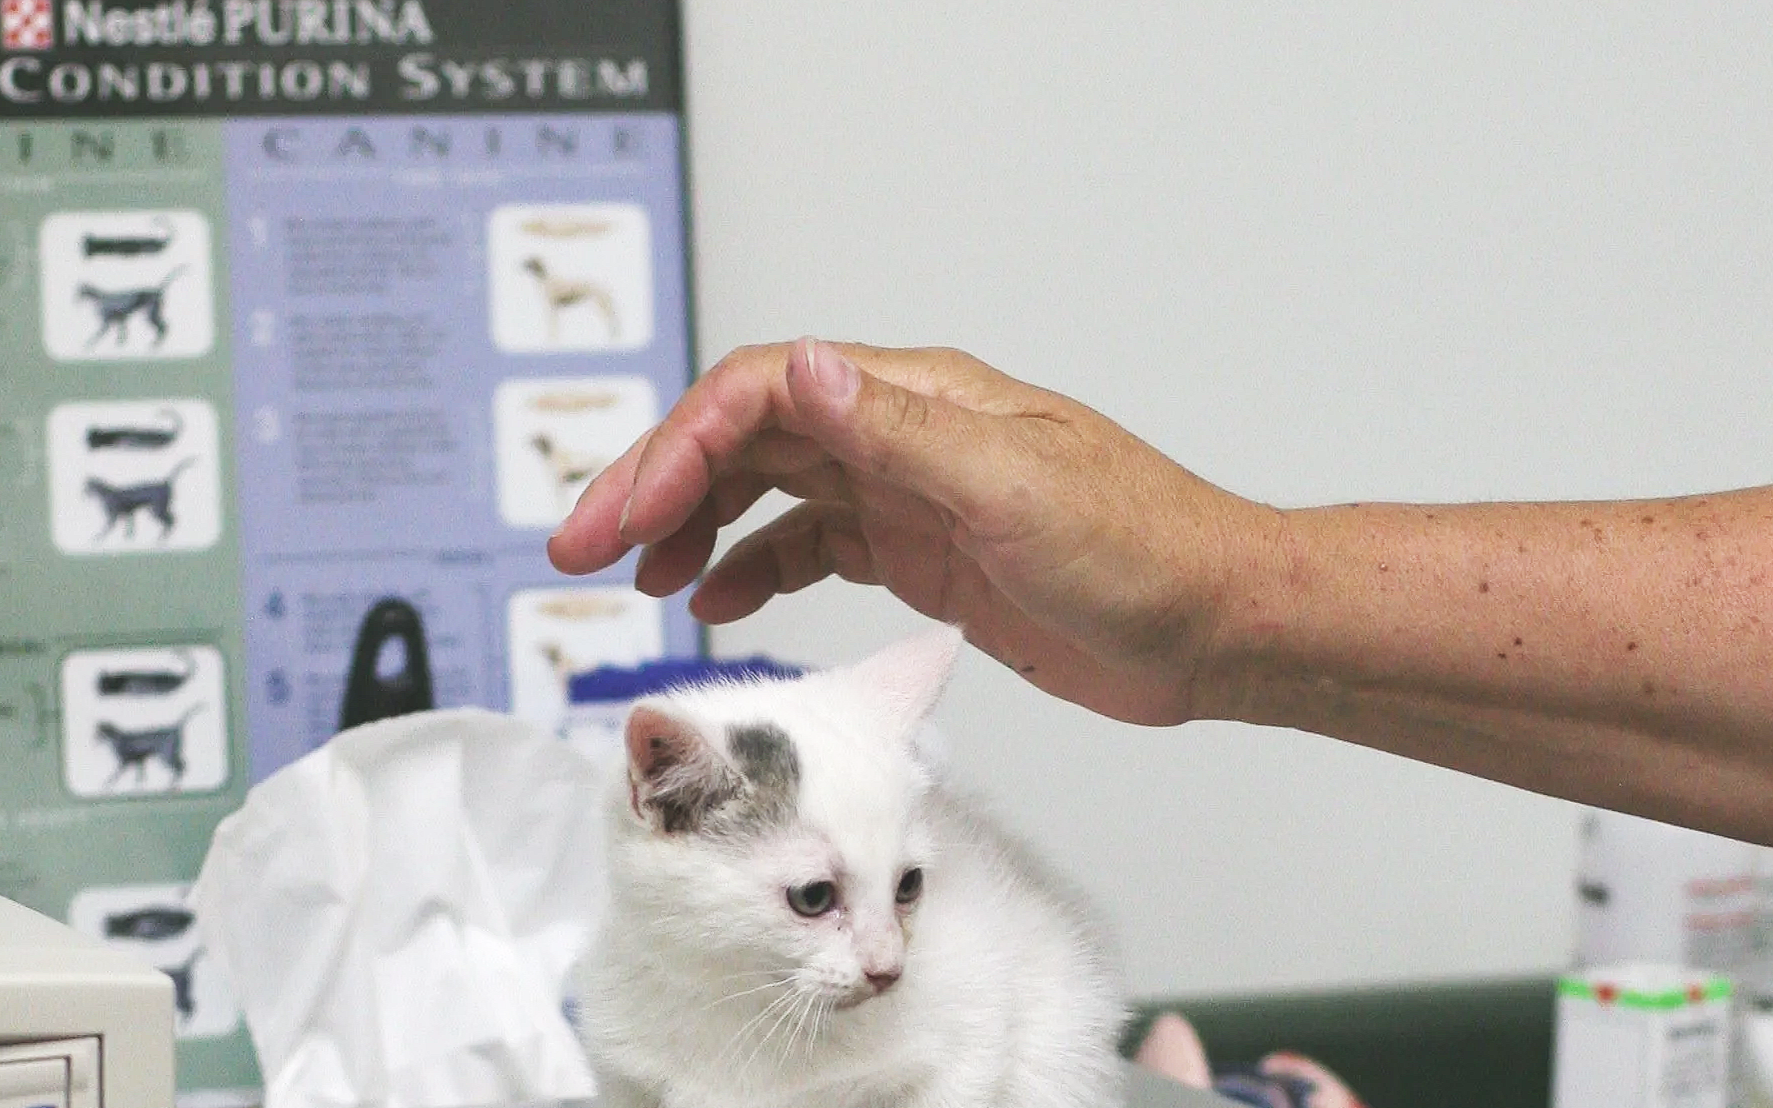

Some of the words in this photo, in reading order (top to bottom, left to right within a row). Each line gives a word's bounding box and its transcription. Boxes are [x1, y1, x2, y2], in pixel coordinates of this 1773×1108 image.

[222, 0, 434, 46] PURINA
[0, 56, 371, 102] CONDITION
[397, 51, 649, 99] SYSTEM
[261, 124, 643, 162] CANINE
